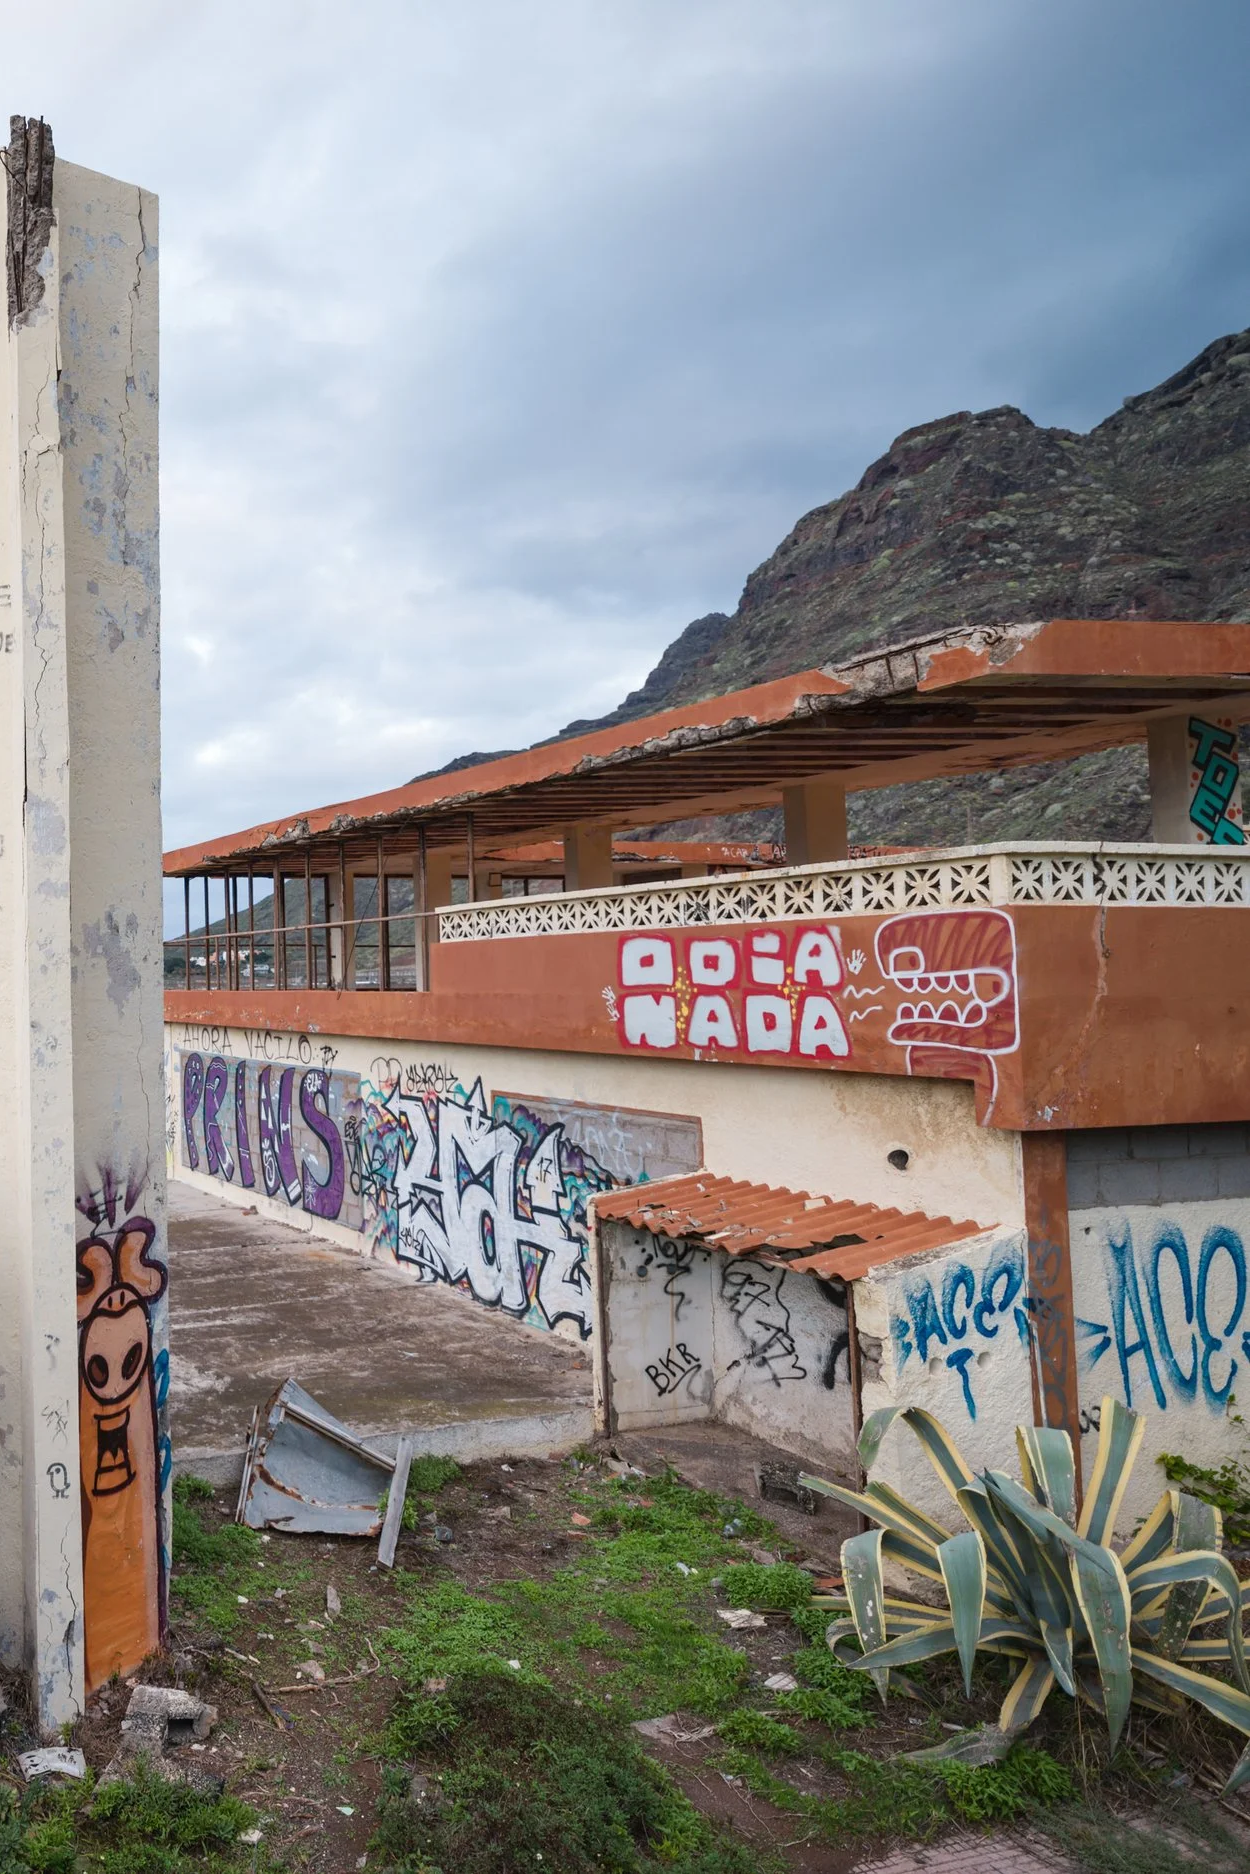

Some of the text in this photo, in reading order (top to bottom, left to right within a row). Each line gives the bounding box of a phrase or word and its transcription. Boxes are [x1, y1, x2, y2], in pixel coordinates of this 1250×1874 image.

[183, 1023, 234, 1057] AHORA
[244, 1030, 313, 1065] VACILO
[618, 989, 853, 1060] NADA
[904, 1236, 1025, 1364] ACE
[1104, 1217, 1247, 1414] ACE
[645, 1343, 701, 1397] BKR
